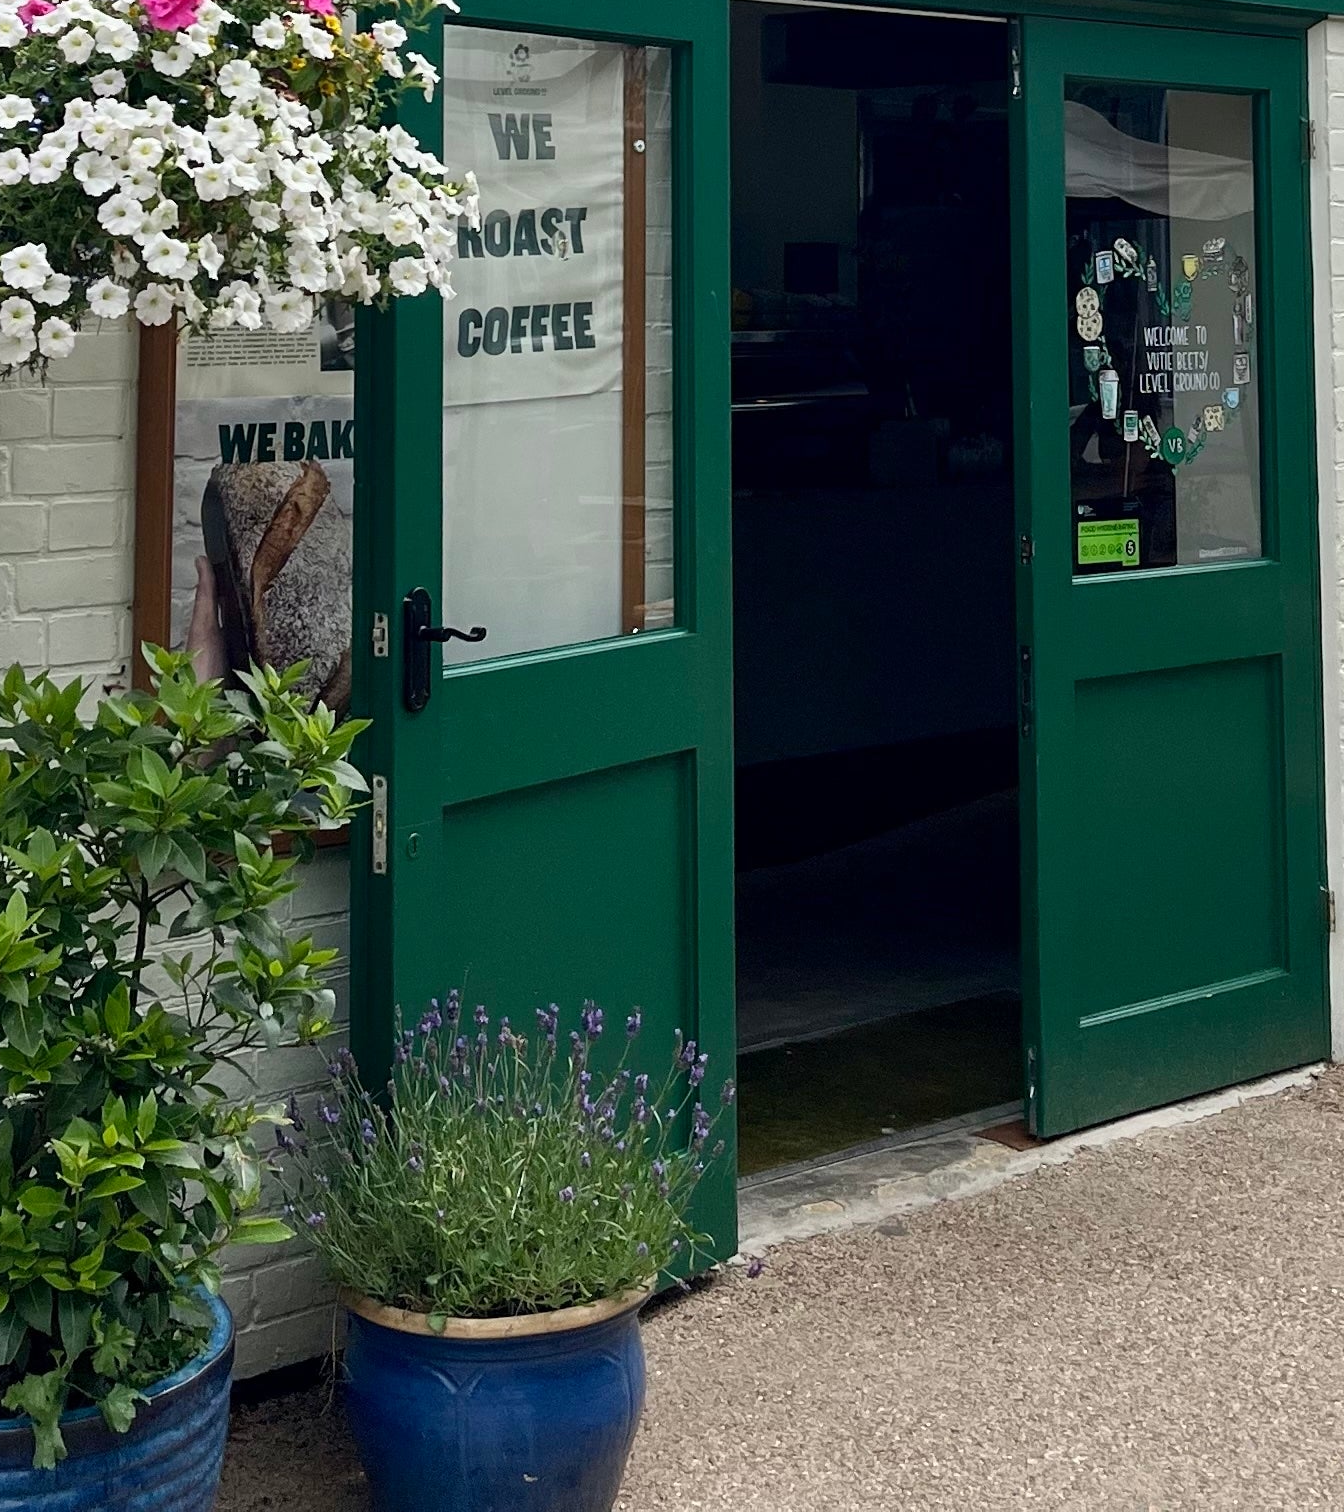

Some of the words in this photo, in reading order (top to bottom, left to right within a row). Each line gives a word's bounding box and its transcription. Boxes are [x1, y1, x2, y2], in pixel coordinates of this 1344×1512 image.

[487, 112, 556, 161] WE
[457, 207, 588, 259] ROAST
[457, 301, 596, 358] COFFEE
[1143, 325, 1190, 347] WELCOME
[1195, 325, 1208, 345] TO
[1146, 351, 1173, 371] VUTIE
[1139, 372, 1171, 394] LEVEL
[1173, 371, 1208, 392] GROUND
[218, 422, 277, 464] WE
